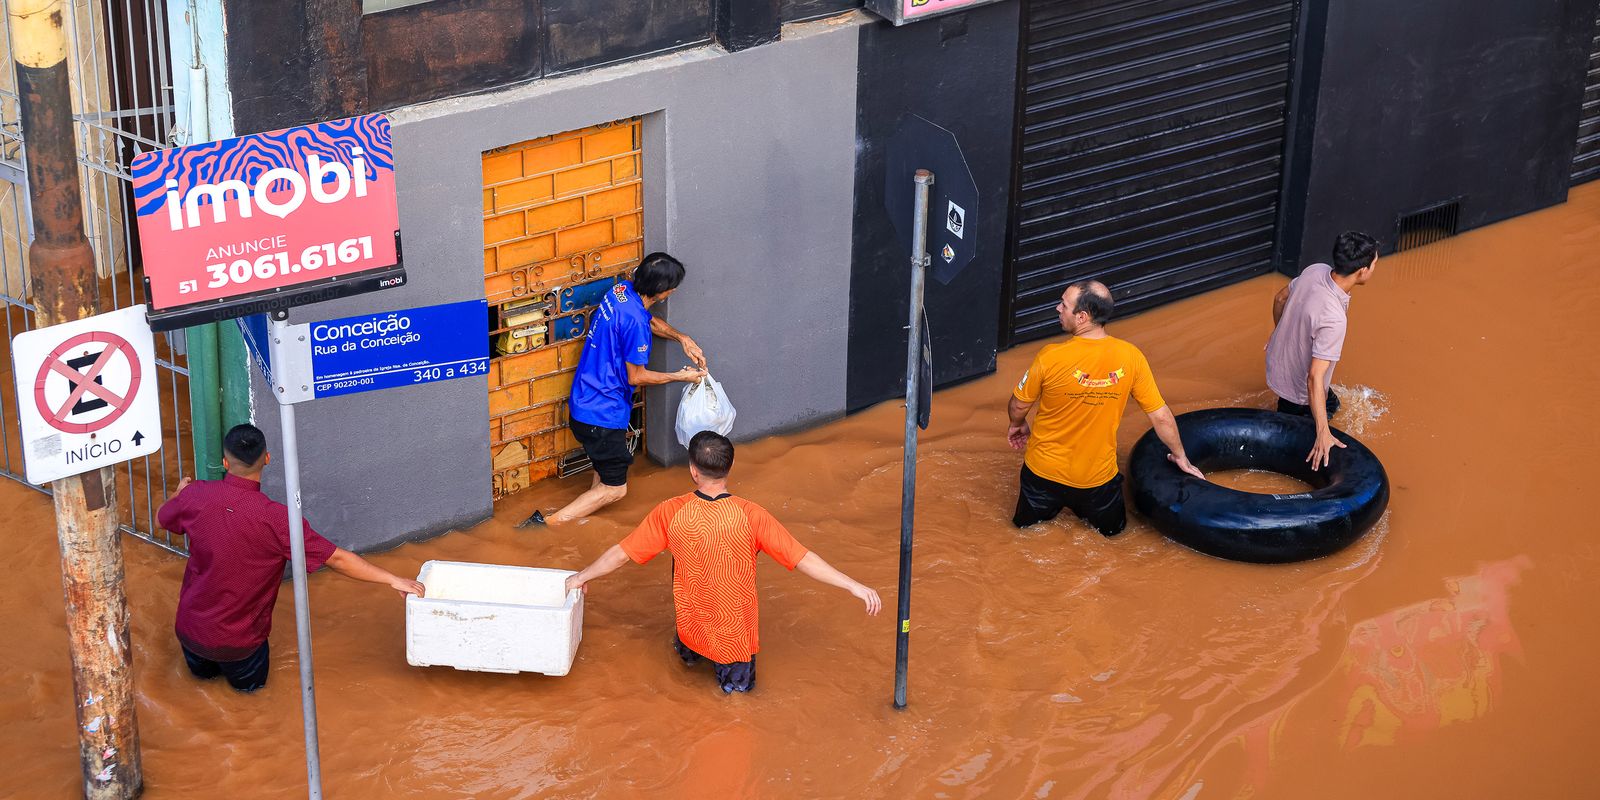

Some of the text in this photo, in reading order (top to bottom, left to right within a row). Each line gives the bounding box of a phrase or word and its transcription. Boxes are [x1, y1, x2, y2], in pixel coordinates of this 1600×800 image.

[165, 147, 368, 231] imobi
[206, 235, 288, 261] ANUNCIE
[179, 236, 374, 294] 51 3061.6161
[380, 276, 403, 287] imobi
[313, 314, 411, 342] Conceição
[314, 331, 421, 356] Rua da Conceição
[316, 377, 375, 392] CEP 90220-001
[413, 361, 487, 382] 340 a 434
[65, 439, 122, 465] INÍCIO
